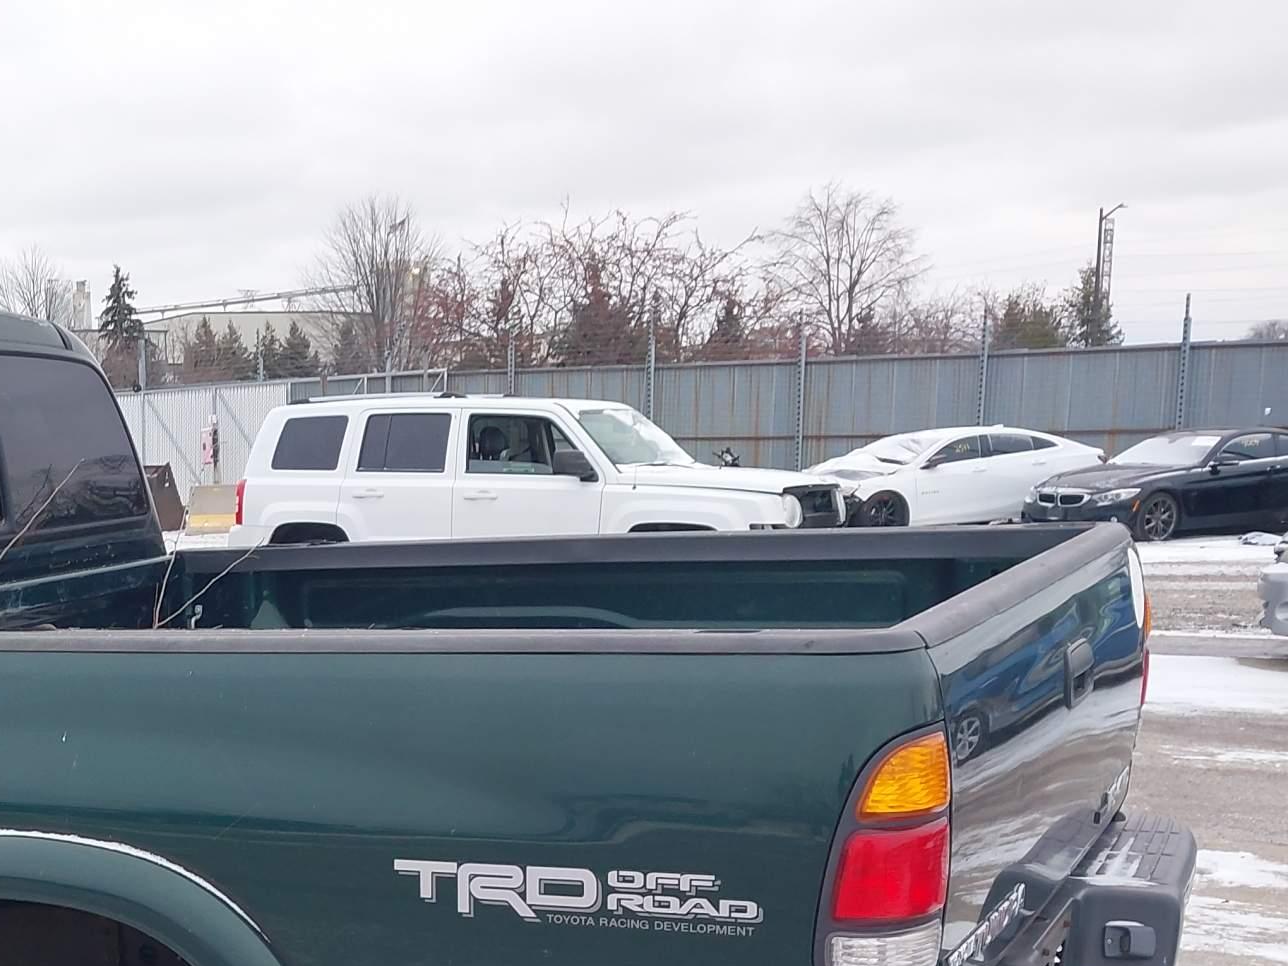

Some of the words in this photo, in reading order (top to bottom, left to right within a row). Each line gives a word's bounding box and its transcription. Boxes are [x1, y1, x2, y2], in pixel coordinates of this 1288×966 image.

[393, 858, 603, 922] TRD
[607, 869, 721, 895] OFF
[606, 892, 764, 924] ROAD
[545, 913, 596, 927] TOYOTA
[599, 916, 650, 930] RACING
[653, 920, 756, 937] DEVELOPMENT
